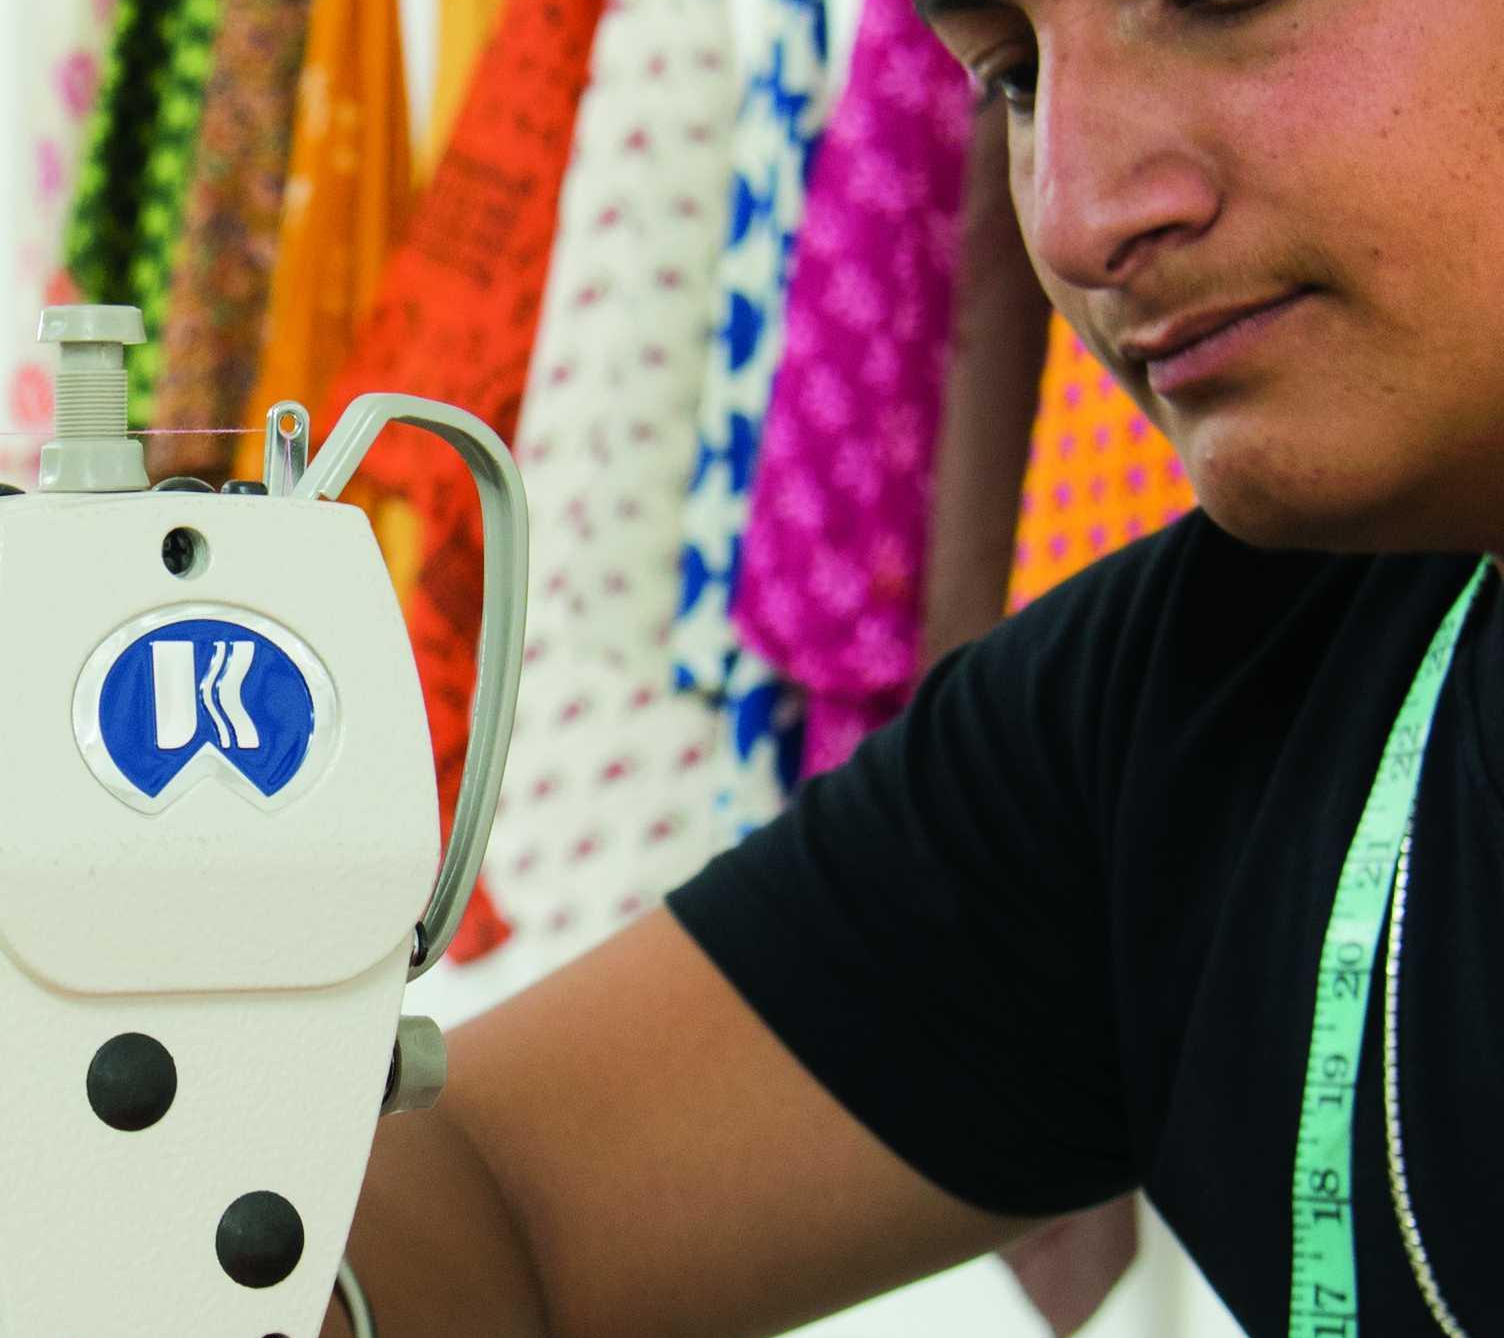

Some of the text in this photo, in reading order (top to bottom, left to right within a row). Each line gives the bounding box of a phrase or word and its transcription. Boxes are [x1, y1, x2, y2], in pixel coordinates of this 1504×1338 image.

[1354, 838, 1392, 890] 21
[1332, 941, 1365, 1002] 20
[1318, 1053, 1349, 1108] 19
[1309, 1167, 1341, 1224] 18
